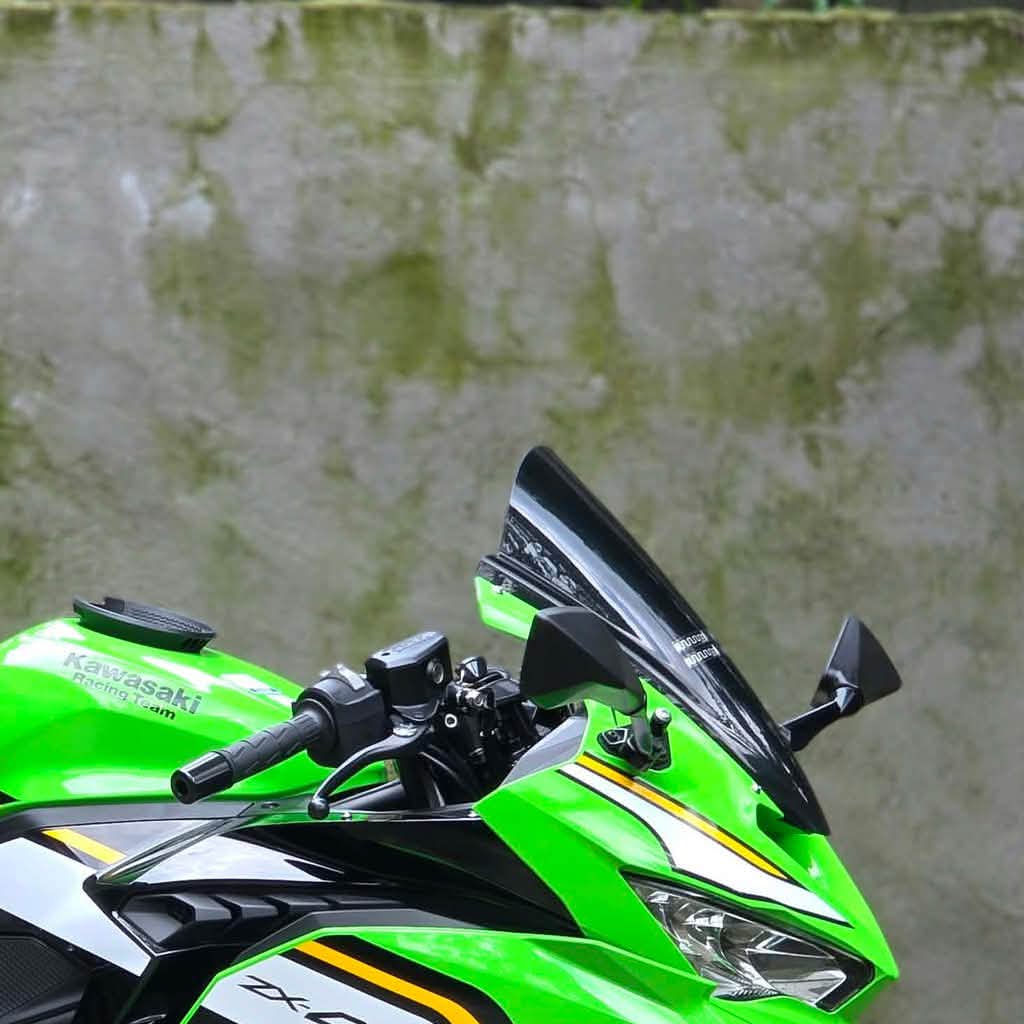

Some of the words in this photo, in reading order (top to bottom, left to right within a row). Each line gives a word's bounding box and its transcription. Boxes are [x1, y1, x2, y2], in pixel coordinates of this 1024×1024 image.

[63, 652, 202, 715] Kawasaki
[73, 672, 129, 702] Racing
[133, 692, 176, 720] Team
